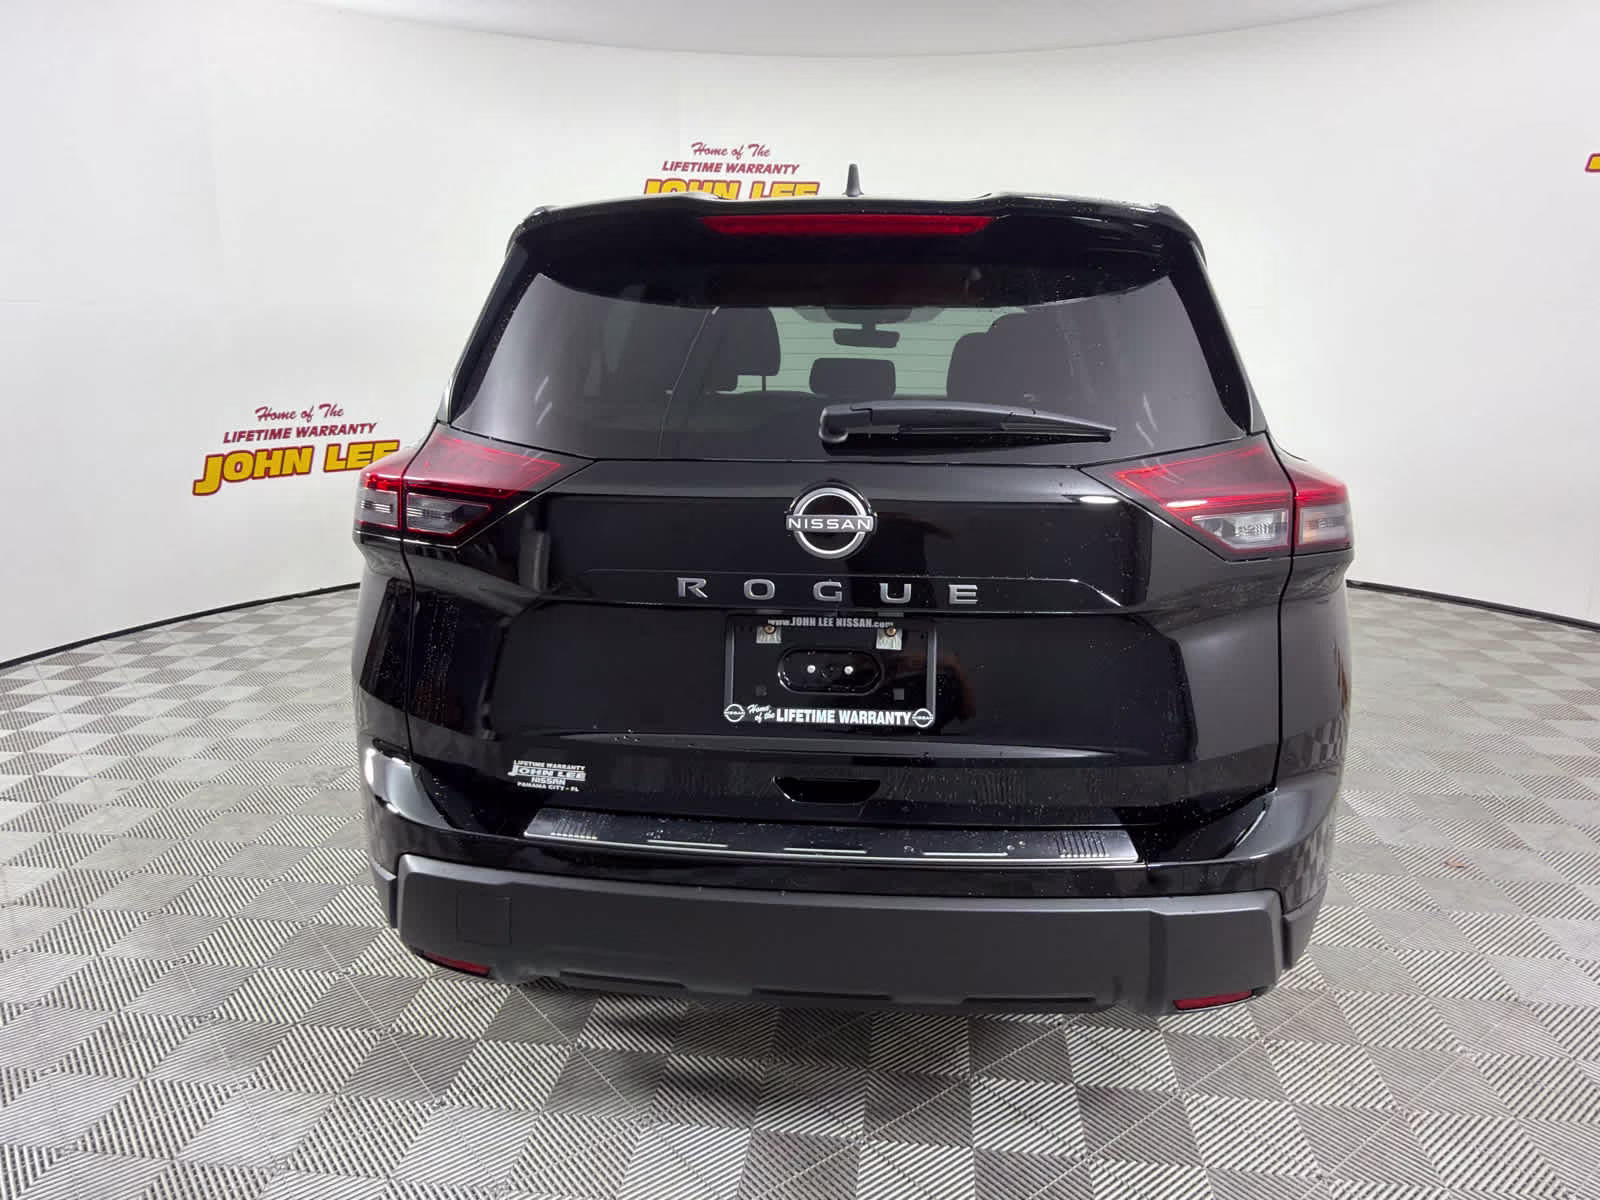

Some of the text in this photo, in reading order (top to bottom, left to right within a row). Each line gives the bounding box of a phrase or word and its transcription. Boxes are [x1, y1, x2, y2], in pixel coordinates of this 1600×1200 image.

[691, 142, 771, 160] Home of The
[662, 161, 800, 175] LIFETIME WARRANTY
[255, 404, 344, 422] Home of The
[223, 423, 377, 443] LIFETIME WARRANTY
[192, 445, 315, 496] JOHN
[788, 517, 872, 531] NISSAN
[677, 577, 978, 605] ROGUE
[818, 617, 834, 627] LEE
[776, 708, 912, 725] LIFETIME WARRANTY
[507, 764, 586, 781] JOHN LEE
[513, 760, 545, 768] LIFETIME
[517, 781, 547, 789] PANAMA
[531, 777, 566, 785] NISSAN
